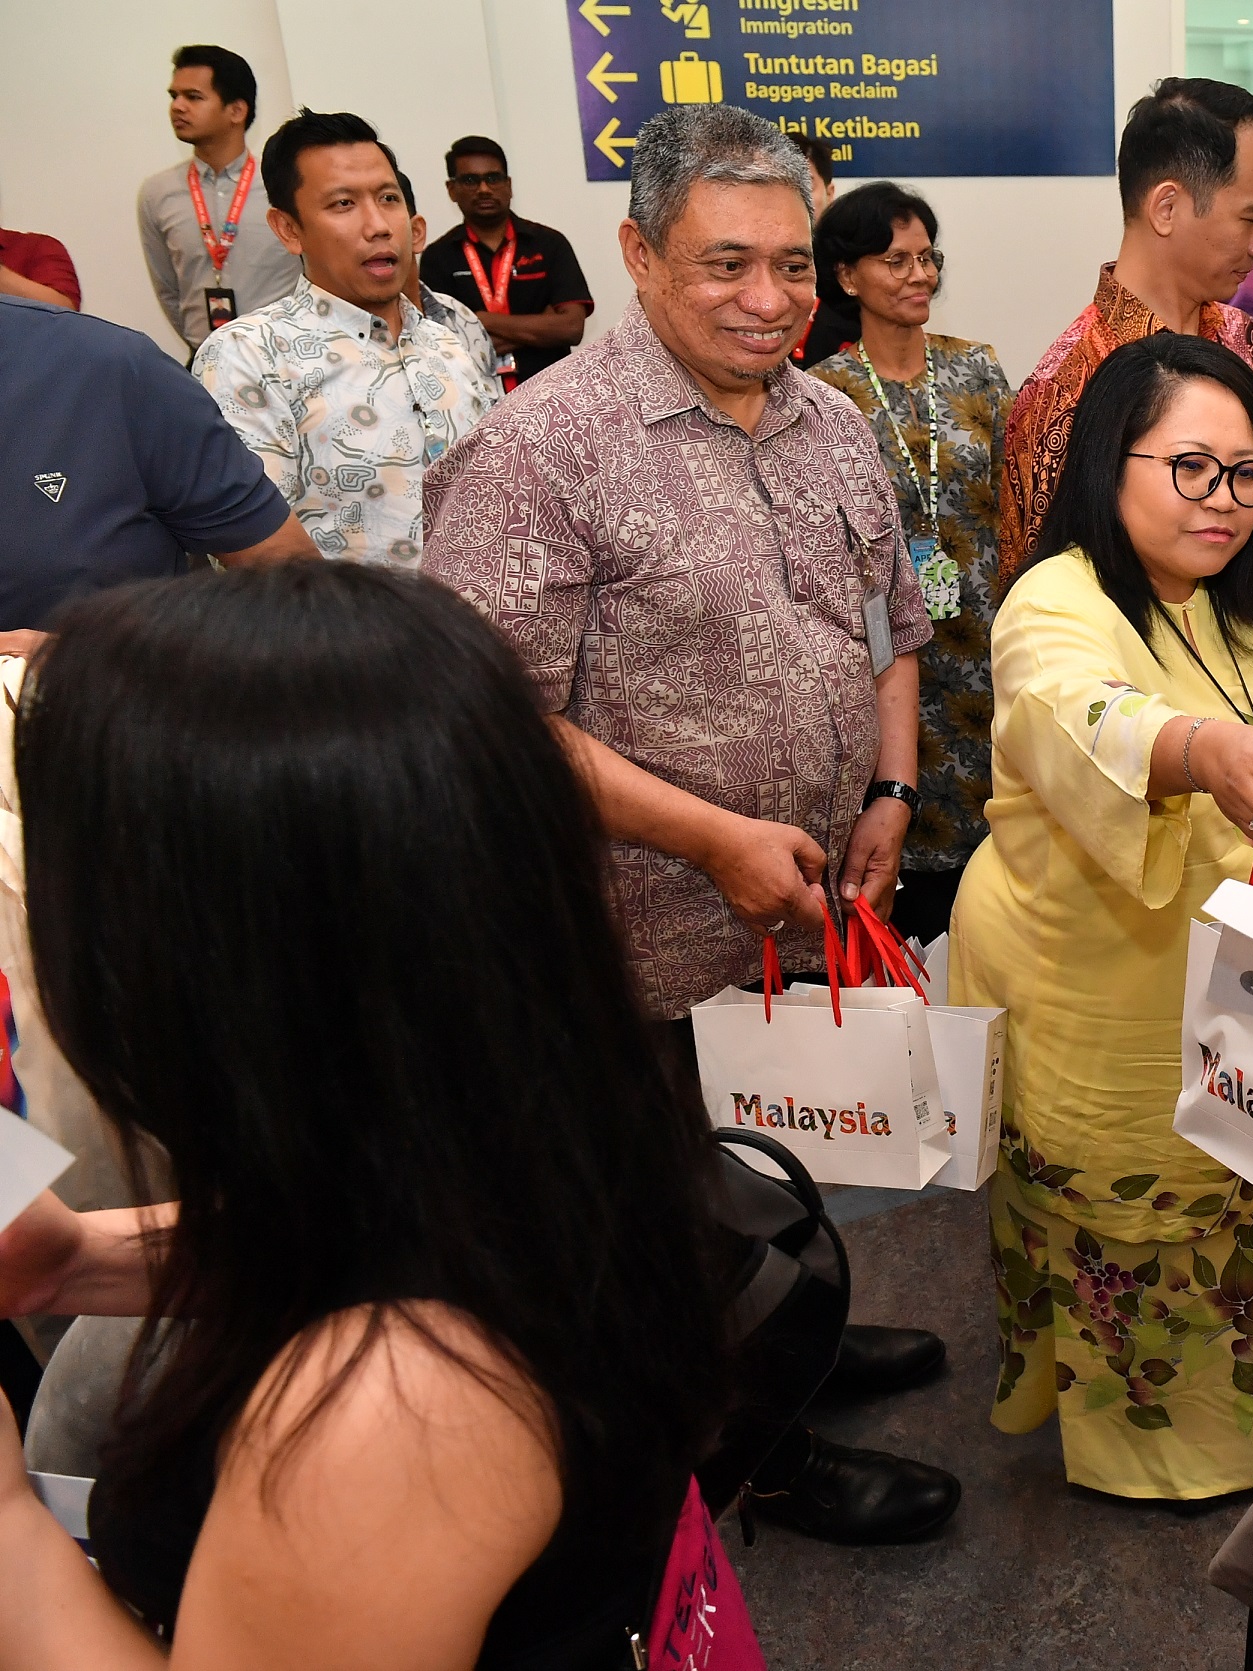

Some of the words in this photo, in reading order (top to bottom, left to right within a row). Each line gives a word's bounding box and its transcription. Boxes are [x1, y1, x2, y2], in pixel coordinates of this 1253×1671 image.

[740, 17, 852, 38] Immigration
[744, 52, 854, 75] Tuntutan
[861, 53, 938, 81] Bagasi
[745, 81, 825, 102] Baggage
[829, 81, 898, 98] Reclaim
[814, 116, 921, 138] Ketibaan
[831, 144, 853, 161] all
[730, 1092, 893, 1140] Malaysia
